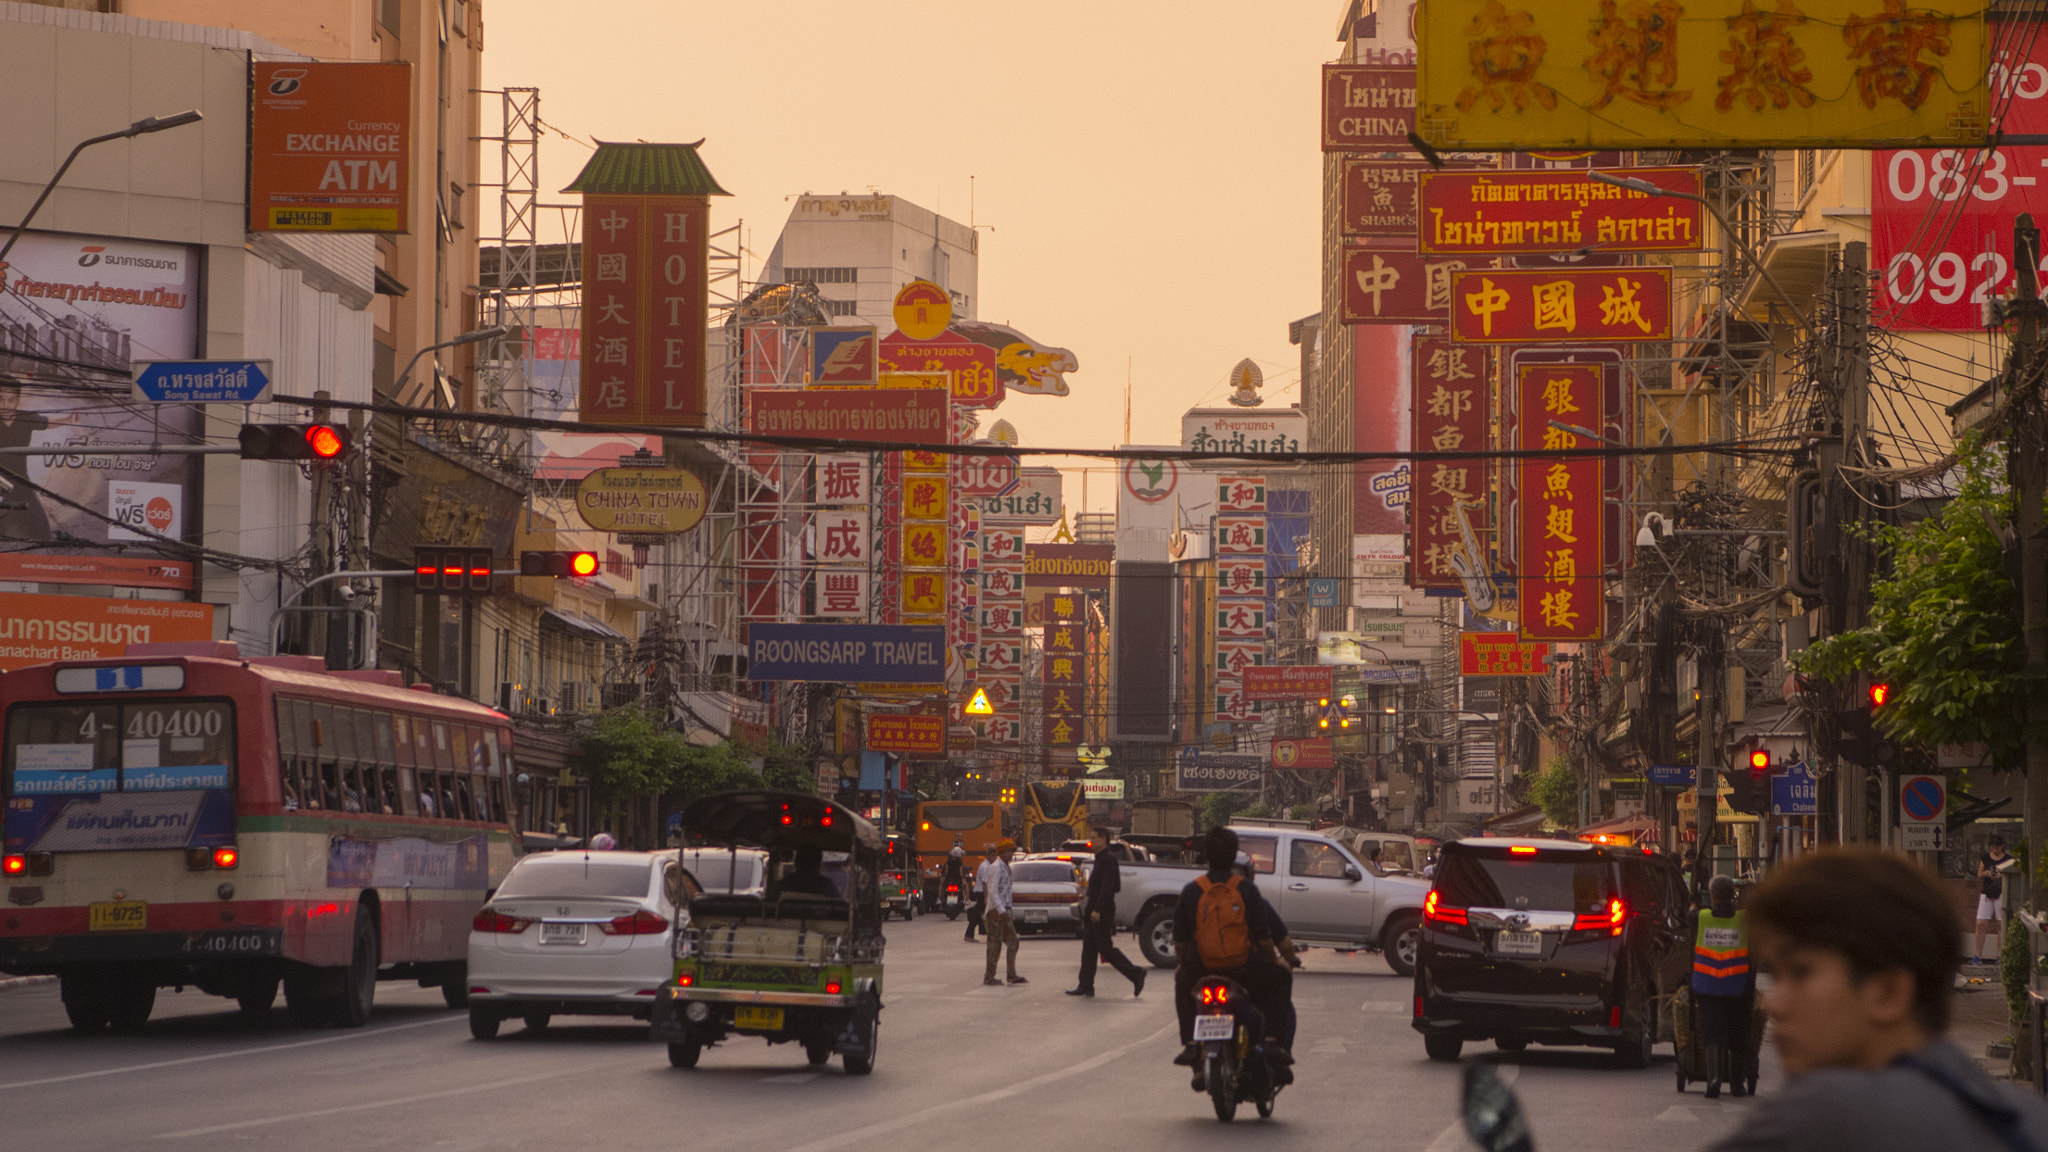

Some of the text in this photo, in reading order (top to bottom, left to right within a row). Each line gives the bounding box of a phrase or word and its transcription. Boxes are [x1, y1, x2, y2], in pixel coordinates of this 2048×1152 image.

[347, 120, 400, 132] Currency
[1339, 118, 1408, 136] CHINA
[287, 134, 400, 152] EXCHANGE
[319, 160, 398, 191] ATM
[1888, 150, 2048, 201] 083-
[1429, 207, 1582, 245] ไชน่าทาวน์
[105, 254, 177, 271] ธนาคารธนชาต
[594, 209, 630, 409] 中國大酒店
[663, 213, 690, 410] HOTEL
[1465, 277, 1652, 337] 中國城
[165, 391, 189, 400] Song
[193, 391, 222, 399] Sawat
[757, 390, 941, 436] ร่งทรัพย์การท่องเที่ยว
[1214, 419, 1275, 431] ห้างขายทอง
[1374, 467, 1410, 492] สดชื่
[585, 492, 699, 509] CHINA TOWN
[1540, 378, 1581, 631] 銀都魚翅酒樓
[614, 513, 669, 527] HOTEL
[823, 461, 861, 612] 振成豐
[148, 567, 180, 577] 1770
[1227, 483, 1256, 718] 和成興大金行
[61, 646, 99, 660] Bank
[754, 639, 938, 665] ROONGSARP TRAVEL
[111, 667, 127, 690] 1
[1364, 669, 1428, 681] BROADWAY HOTL
